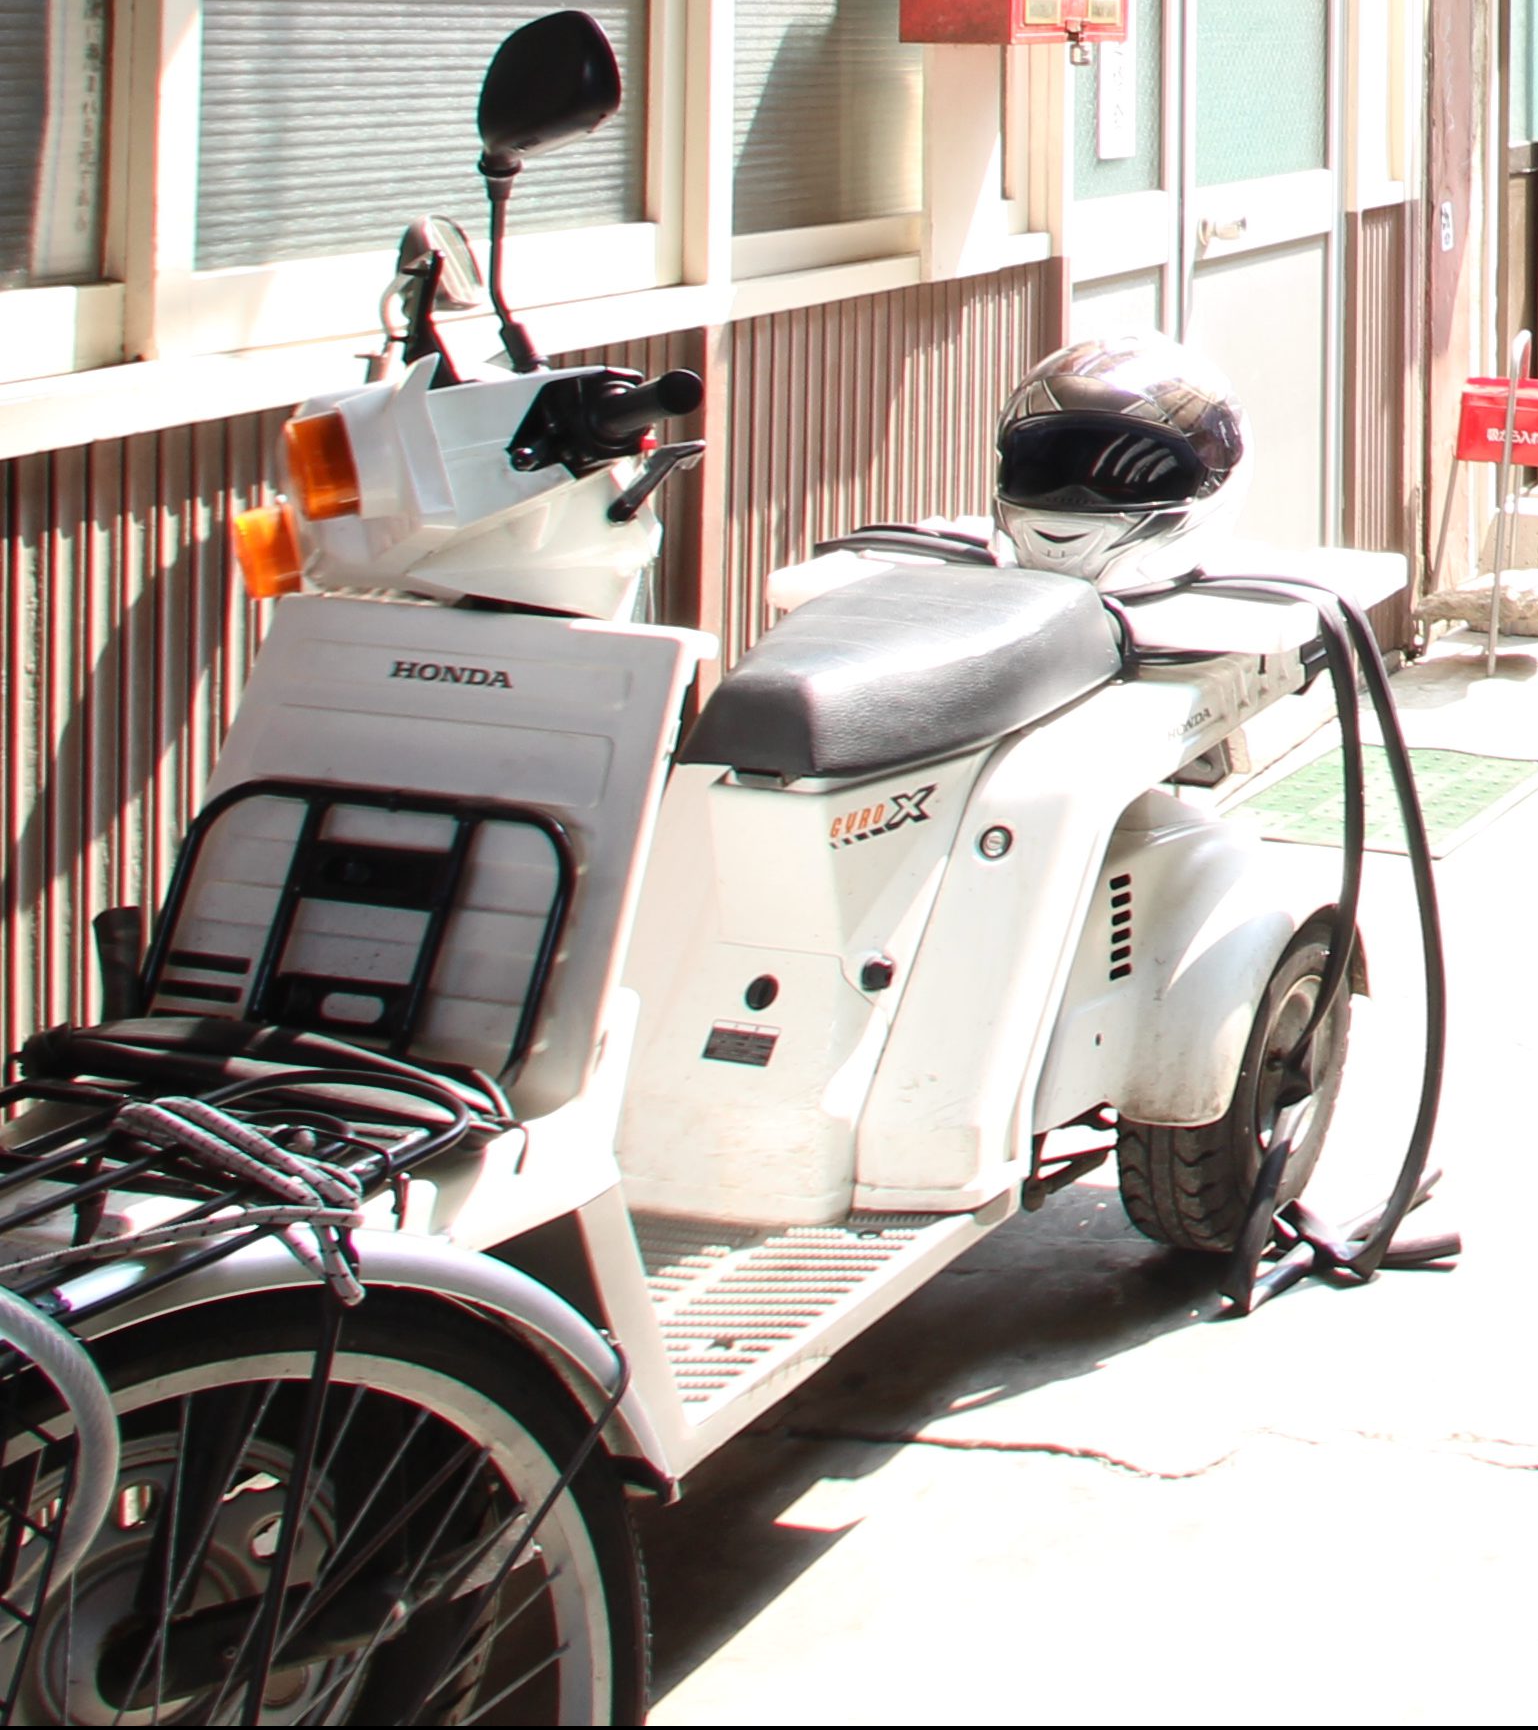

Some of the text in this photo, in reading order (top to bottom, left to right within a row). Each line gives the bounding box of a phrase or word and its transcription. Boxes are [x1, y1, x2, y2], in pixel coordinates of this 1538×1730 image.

[389, 660, 515, 690] HONDA
[829, 784, 938, 840] GYRO X
